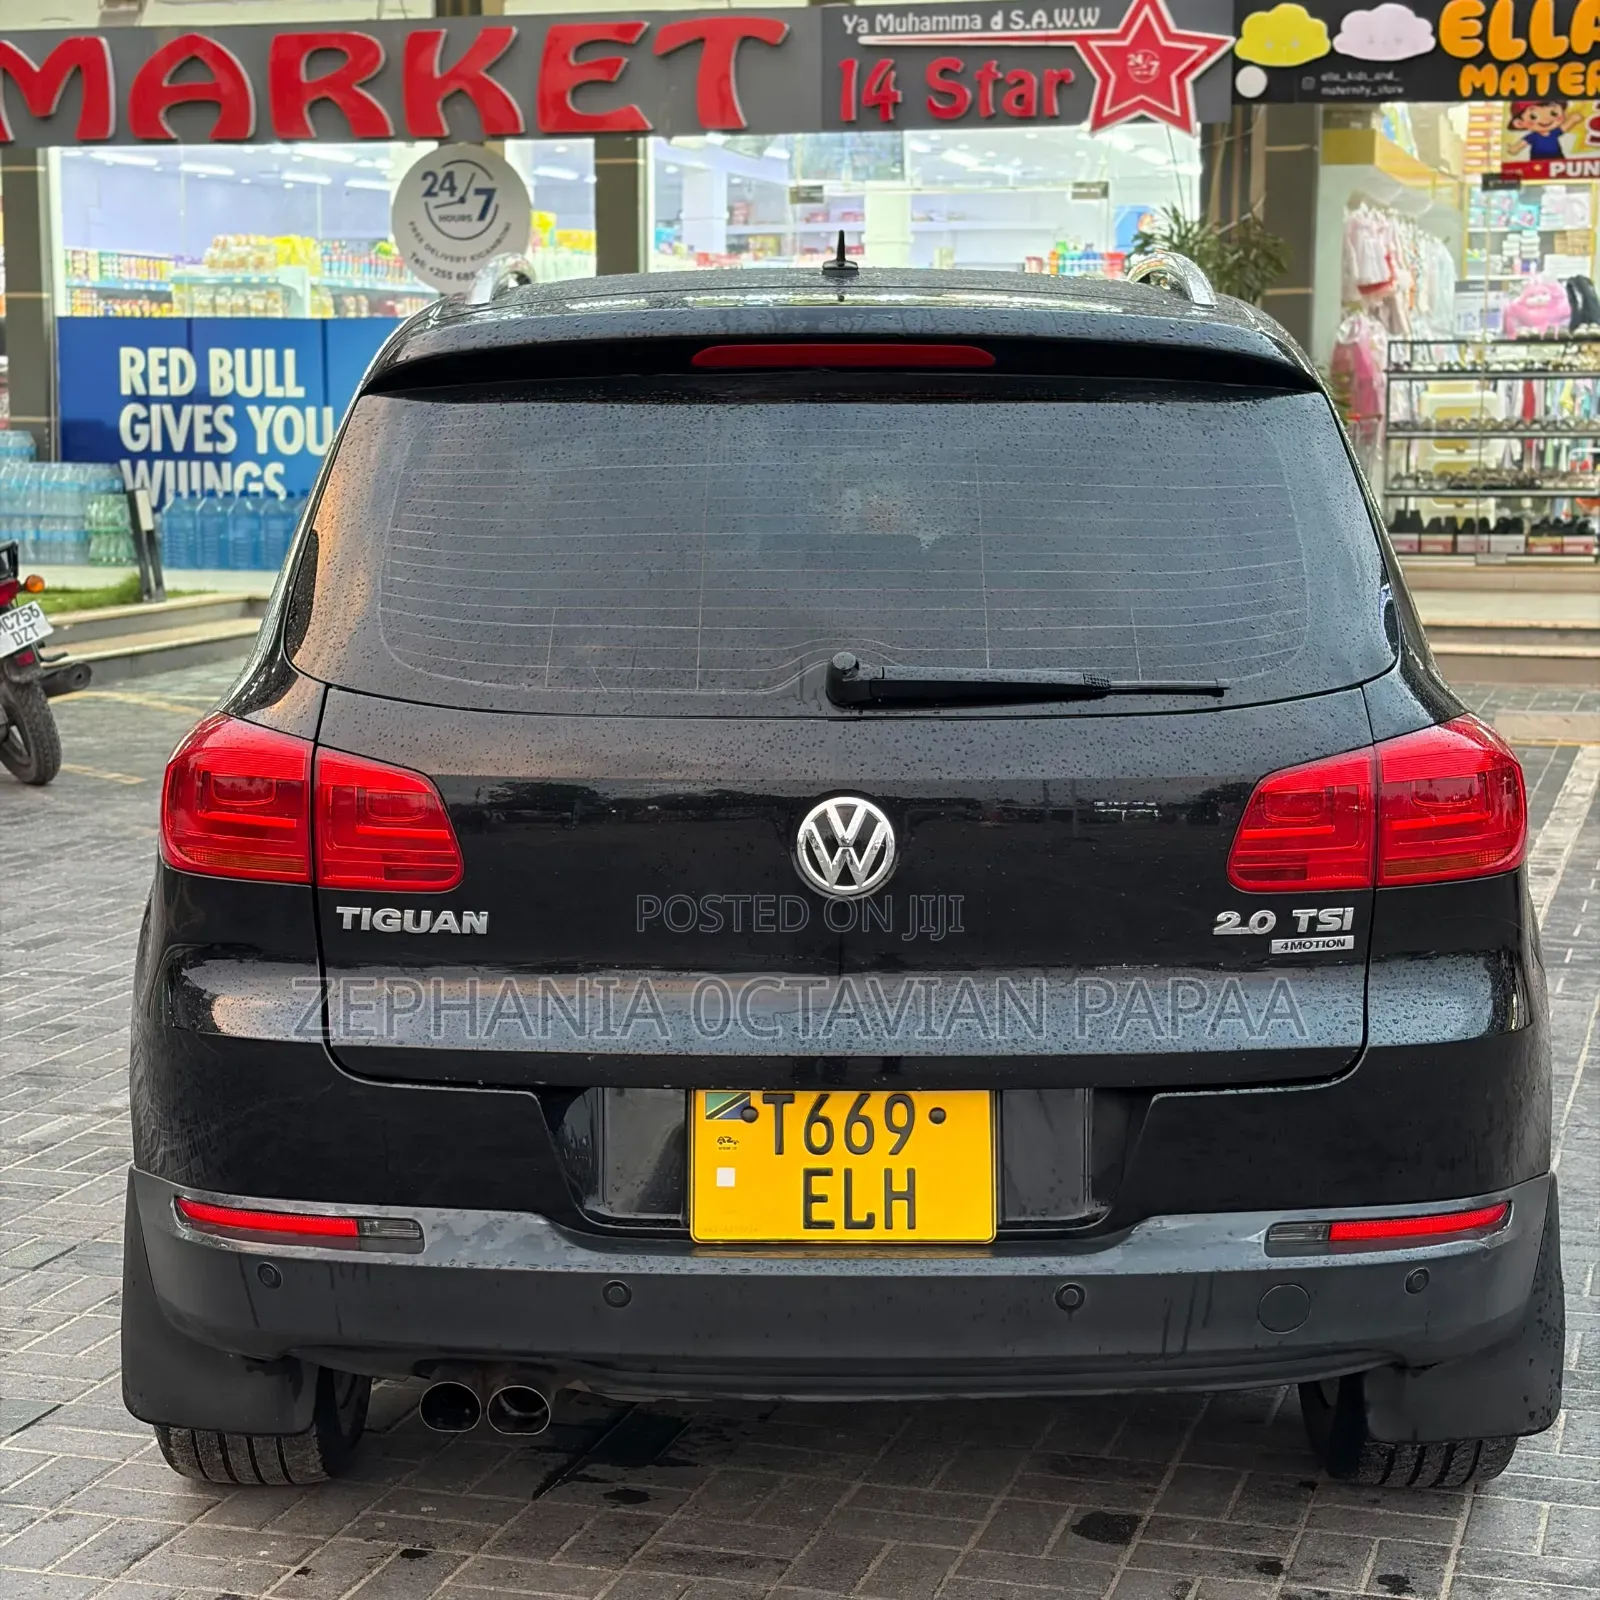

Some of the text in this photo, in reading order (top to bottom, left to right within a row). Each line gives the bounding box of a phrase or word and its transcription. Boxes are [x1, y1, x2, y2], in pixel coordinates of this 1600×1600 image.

[842, 8, 1100, 34] Ya Muhamma d S.A.W.W
[0, 17, 789, 141] MARKET
[838, 57, 1074, 122] 14 Star
[1549, 161, 1600, 177] PUN
[438, 214, 473, 223] HOURS
[409, 220, 424, 244] FREE
[424, 243, 467, 263] DELIVERY
[429, 267, 453, 280] +255
[119, 347, 305, 398] RED BULL
[119, 402, 335, 456] GIVES YOU
[11, 623, 40, 647] DZT
[799, 799, 894, 891] VW
[336, 906, 488, 935] TIGUAN
[1213, 907, 1354, 935] 2.0 TSI
[1280, 938, 1346, 951] 4MOTION
[762, 1093, 916, 1156] T669
[803, 1167, 917, 1230] ELH
